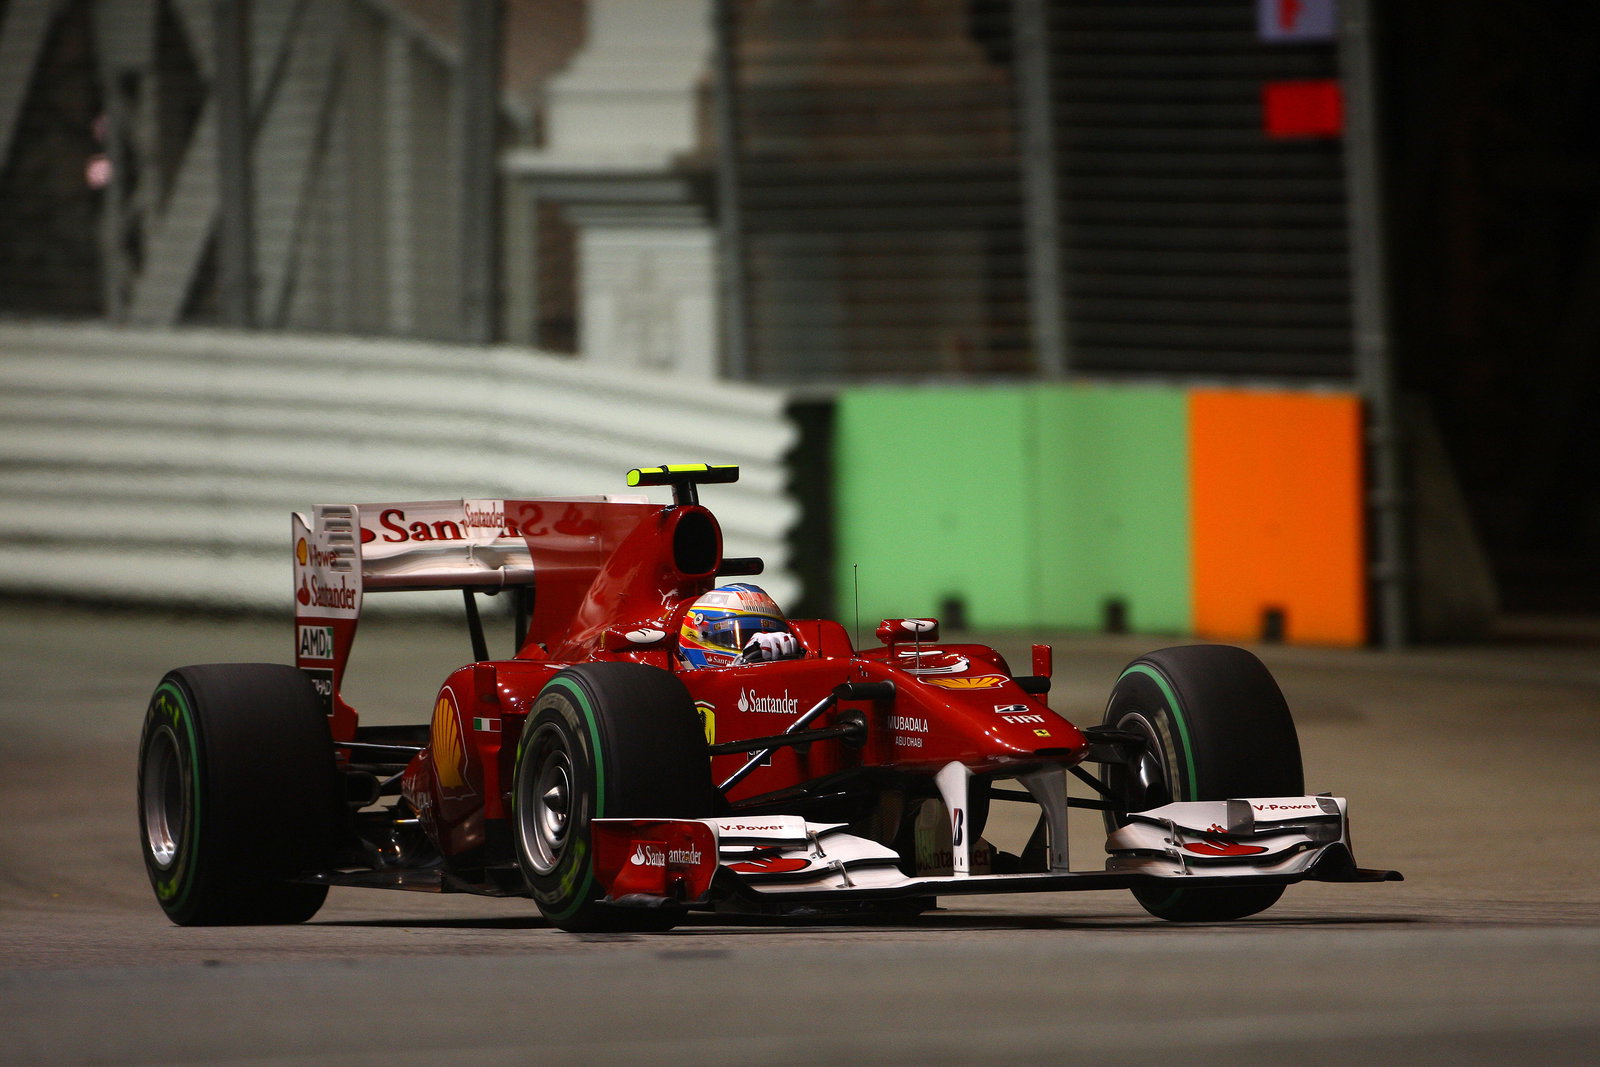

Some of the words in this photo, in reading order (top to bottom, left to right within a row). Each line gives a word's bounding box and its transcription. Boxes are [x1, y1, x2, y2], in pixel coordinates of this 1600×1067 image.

[311, 574, 356, 609] Santander
[301, 628, 325, 656] AMD
[749, 688, 798, 714] Santander
[888, 715, 929, 733] MUBADALA
[1001, 714, 1046, 724] FIAT
[895, 736, 907, 747] ABU
[907, 736, 923, 748] DHABI
